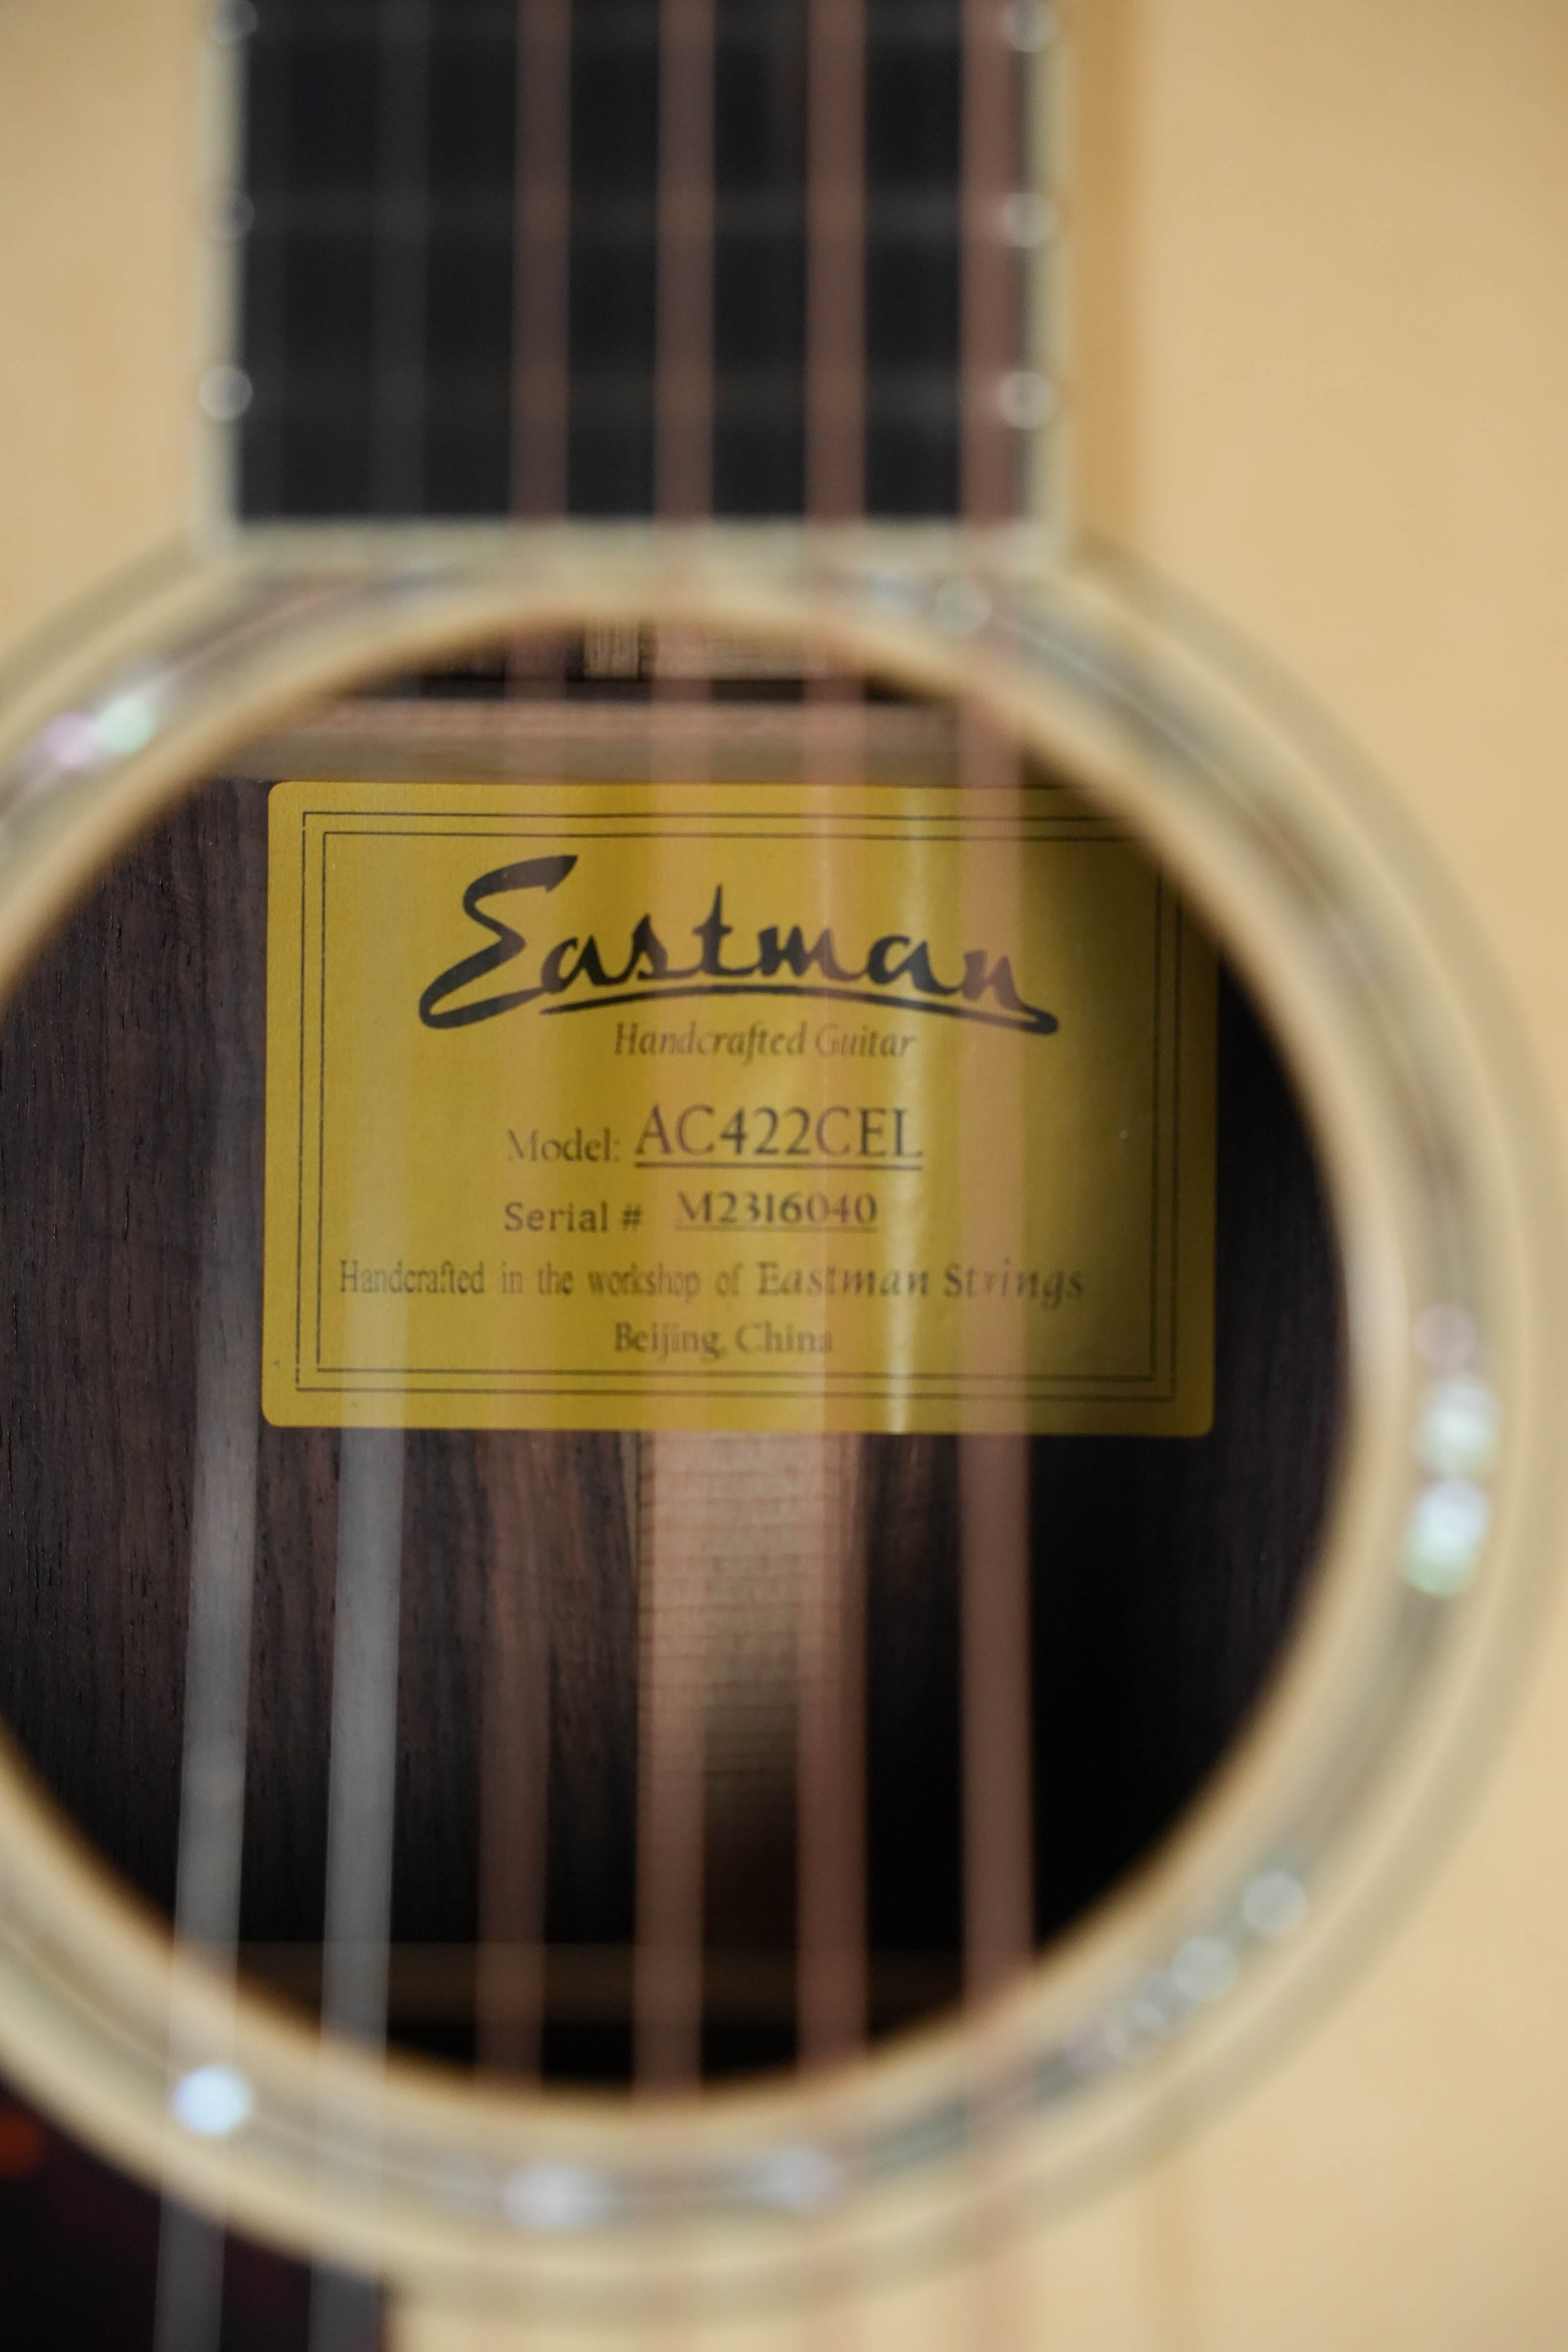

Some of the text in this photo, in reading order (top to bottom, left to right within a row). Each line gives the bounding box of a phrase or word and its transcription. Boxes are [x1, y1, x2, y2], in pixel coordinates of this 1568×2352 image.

[420, 855, 1059, 1035] Eastman
[614, 1019, 916, 1066] Handcrafted Guitar
[507, 1103, 923, 1162] Model: AC422CEL
[504, 1200, 609, 1233] Serial
[621, 1202, 644, 1233] #
[340, 1258, 1085, 1311] Handcrafted in the workshop of Eastman Strings
[735, 1320, 835, 1354] China
